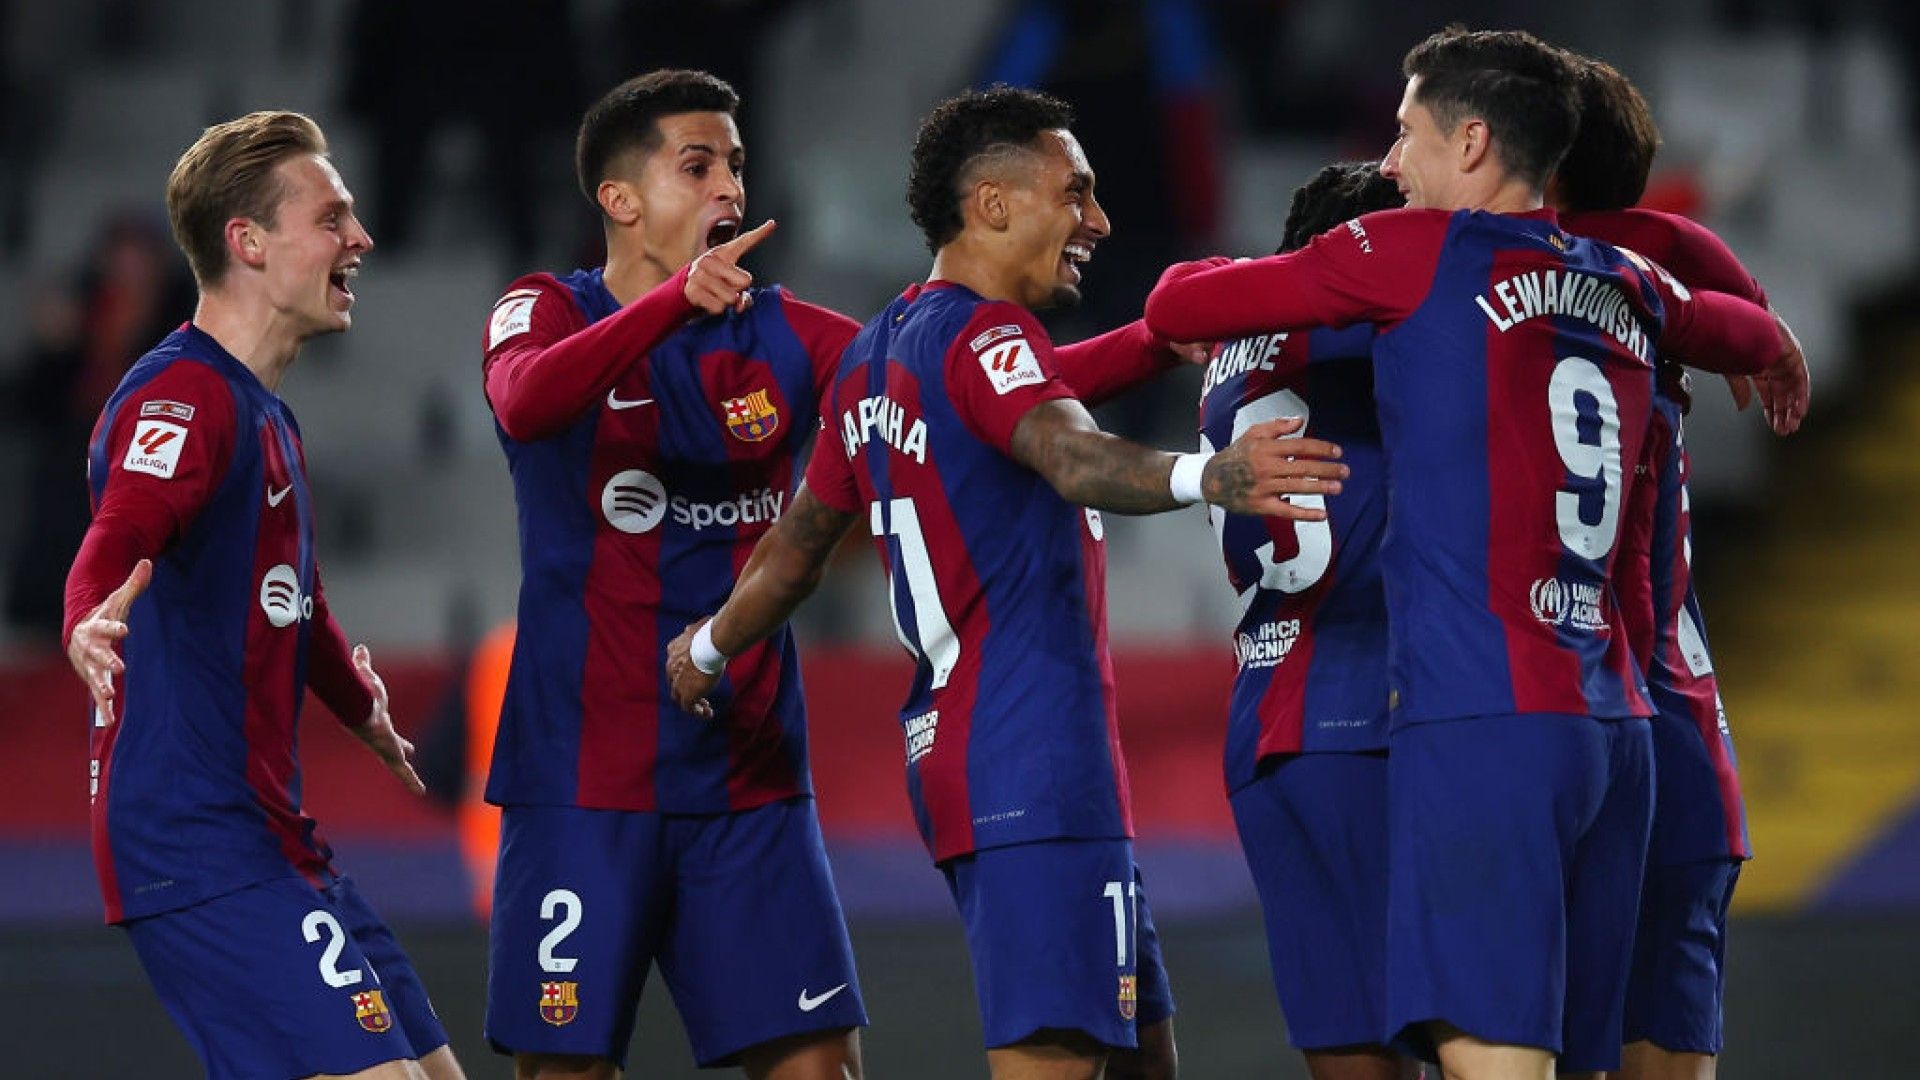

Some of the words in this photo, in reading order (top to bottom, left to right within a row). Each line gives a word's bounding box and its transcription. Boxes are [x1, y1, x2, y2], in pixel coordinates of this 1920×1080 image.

[1475, 269, 1649, 363] LEWANDOWSKI
[1200, 332, 1288, 408] OUNDE
[130, 457, 168, 472] LALIGA
[1549, 356, 1622, 560] 9
[671, 487, 784, 531] Spotify
[538, 889, 582, 973] 2
